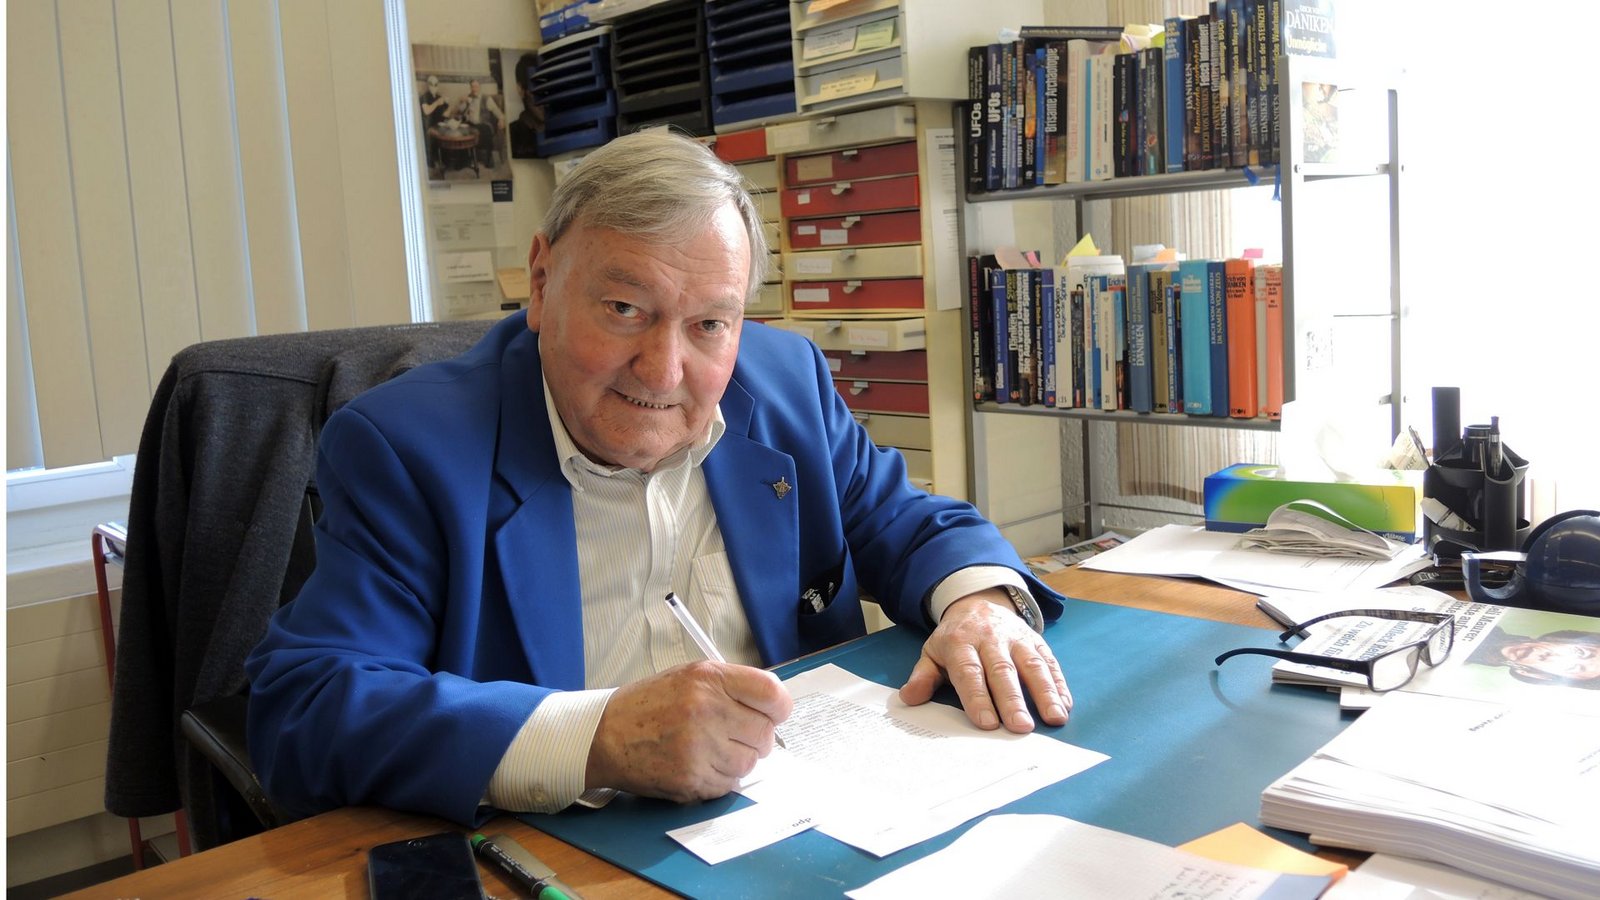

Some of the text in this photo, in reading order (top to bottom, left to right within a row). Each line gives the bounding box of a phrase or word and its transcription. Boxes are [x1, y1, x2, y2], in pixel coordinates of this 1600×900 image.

[1217, 19, 1225, 41] BUCH
[1257, 5, 1266, 41] STEINZEIT
[1272, 2, 1280, 42] Wahrheiten
[1045, 48, 1059, 133] Brisante Archäologie
[1185, 63, 1193, 110] DÄNIKEN
[971, 102, 982, 137] UFOs
[987, 91, 1001, 123] UFOs
[1233, 99, 1241, 136] DÄNIKEN
[1250, 97, 1258, 134] DÄNIKEN
[1259, 95, 1268, 133] DÄNIKEN
[1015, 272, 1023, 319] Däniken
[1008, 313, 1018, 351] Däniken
[1022, 272, 1031, 374] Die Augen der Sphinx
[1135, 324, 1145, 366] DÄNIKEN
[1333, 628, 1361, 647] weich
[1357, 620, 1374, 629] Zu
